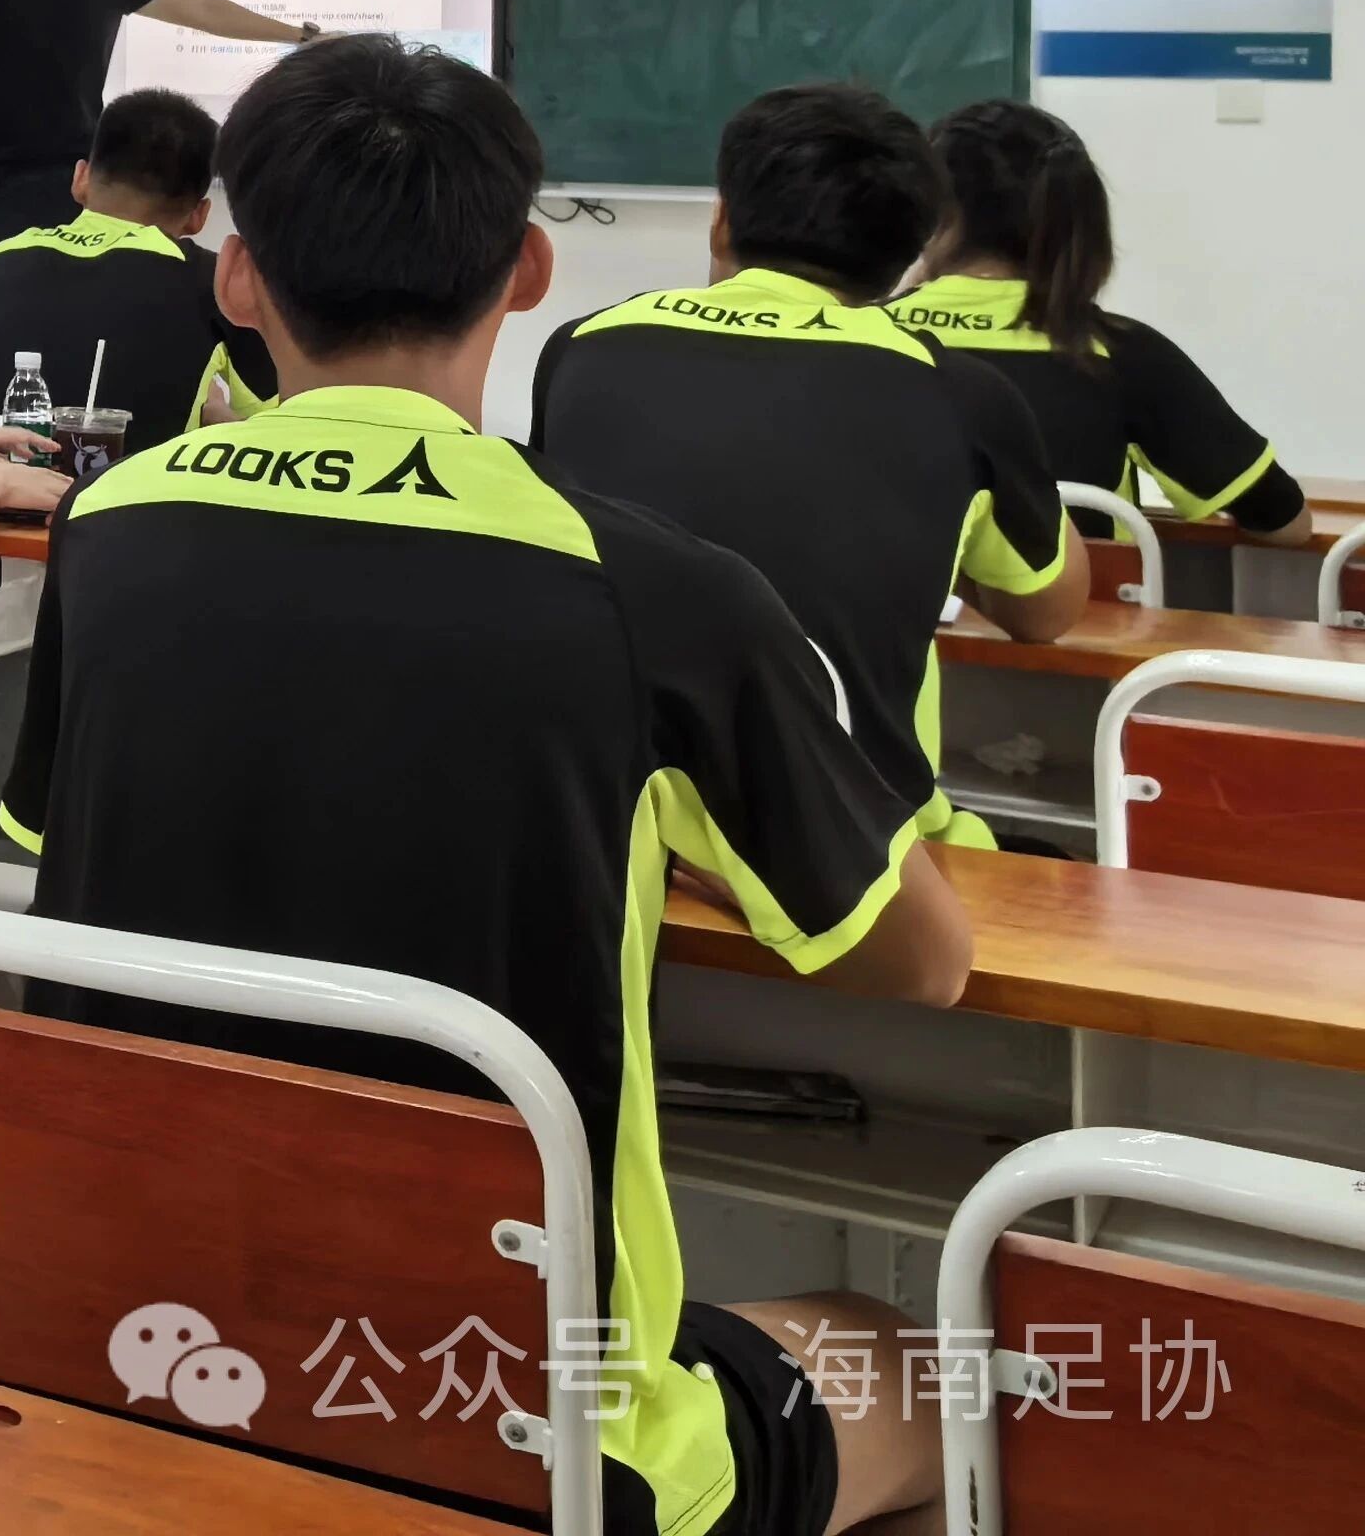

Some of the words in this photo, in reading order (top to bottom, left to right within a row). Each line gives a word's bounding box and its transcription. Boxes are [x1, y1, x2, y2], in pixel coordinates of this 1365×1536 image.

[654, 293, 781, 328] LOOKS
[893, 307, 993, 331] LOOKS
[165, 442, 355, 493] LOOKS
